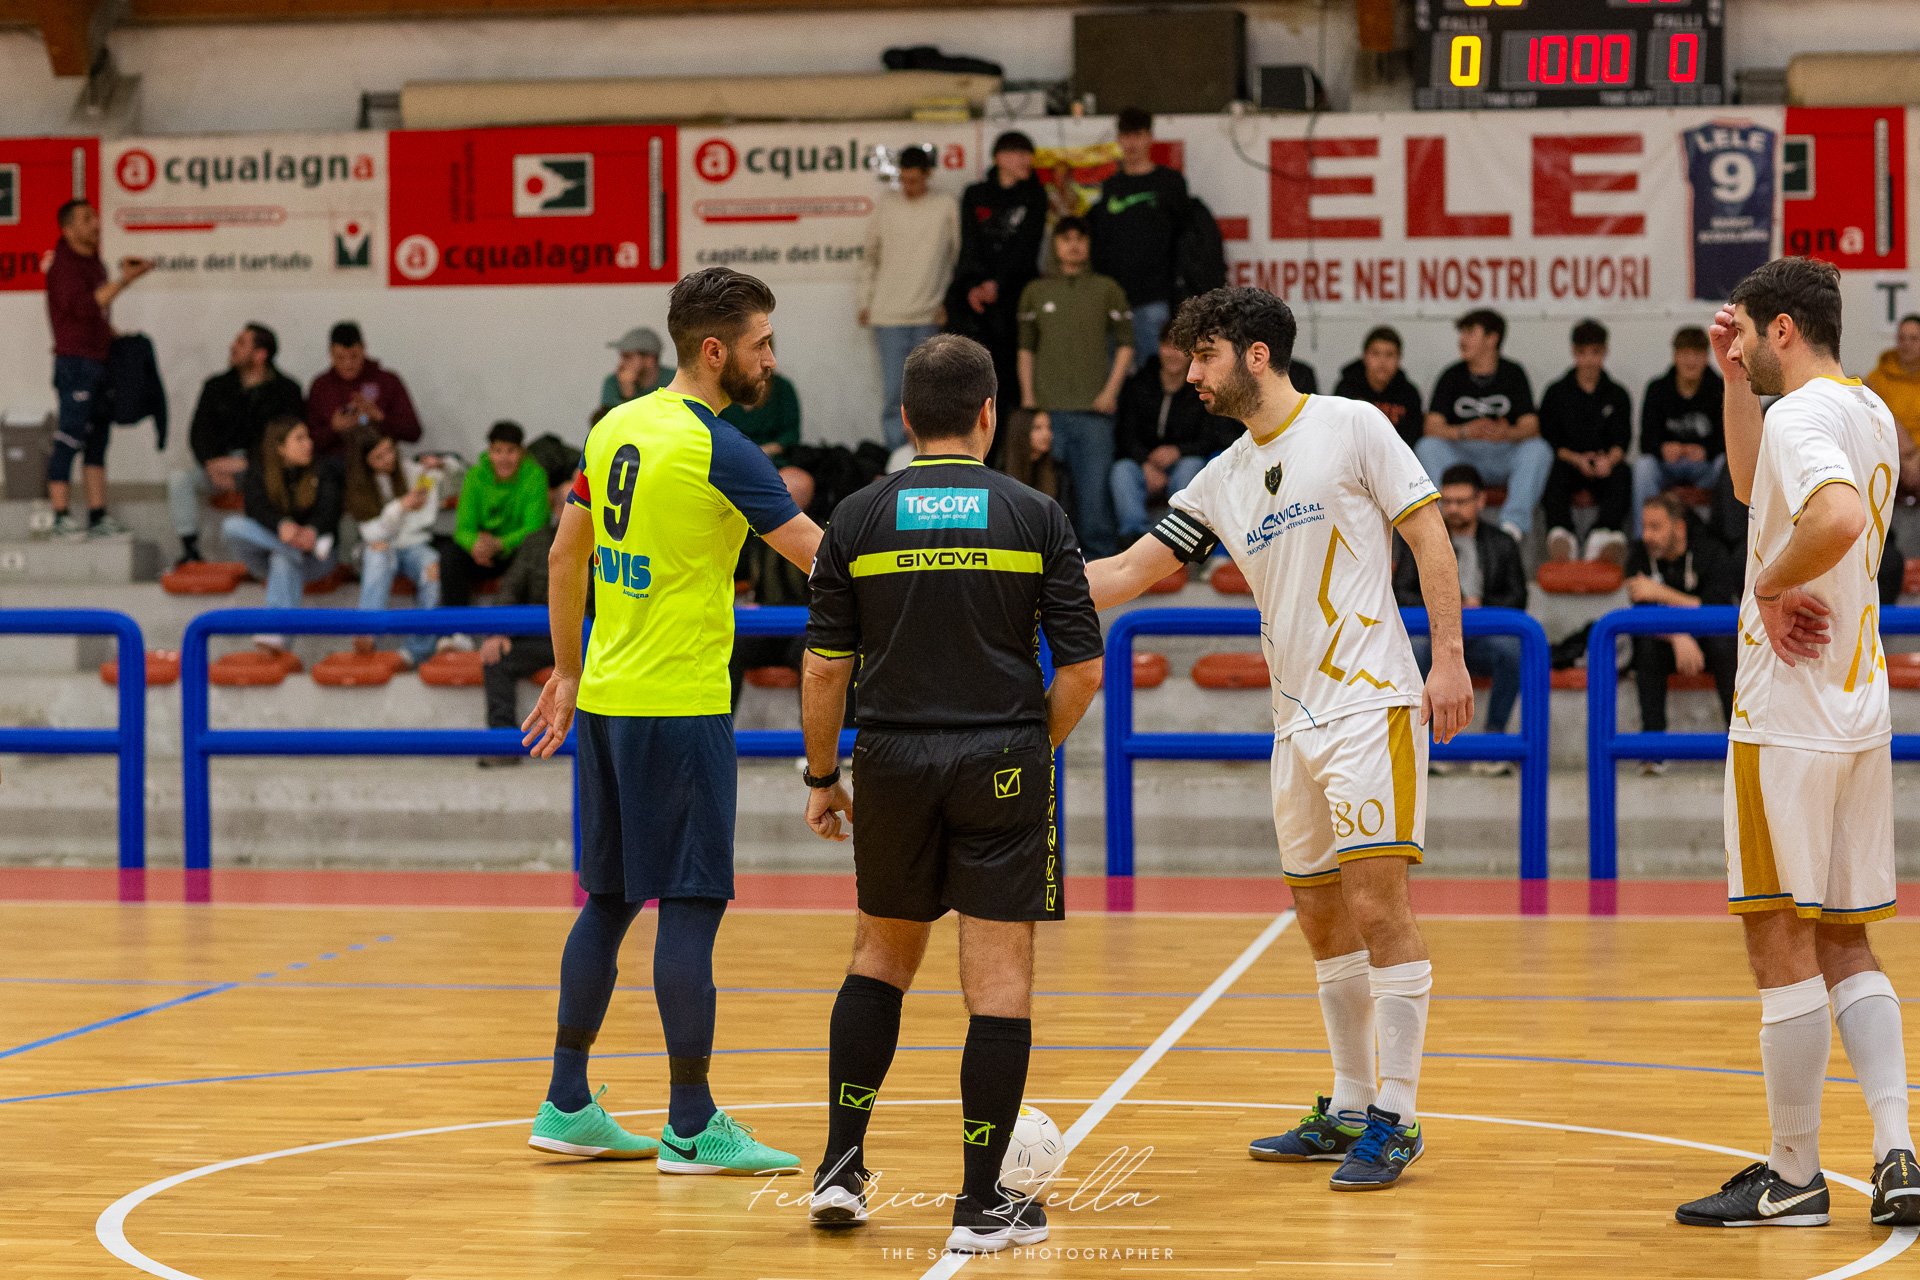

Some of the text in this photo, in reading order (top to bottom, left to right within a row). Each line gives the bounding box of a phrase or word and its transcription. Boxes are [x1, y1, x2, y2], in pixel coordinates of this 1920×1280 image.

[1450, 35, 1481, 87] 0
[1668, 33, 1699, 83] 0
[1695, 129, 1767, 153] LELE
[1709, 151, 1756, 204] 9
[1354, 259, 1405, 300] NEI
[1418, 257, 1536, 299] NOSTRI
[1548, 256, 1650, 298] CUORI
[603, 443, 641, 542] 9
[896, 551, 988, 568] GIVOVA
[1335, 798, 1385, 838] 80
